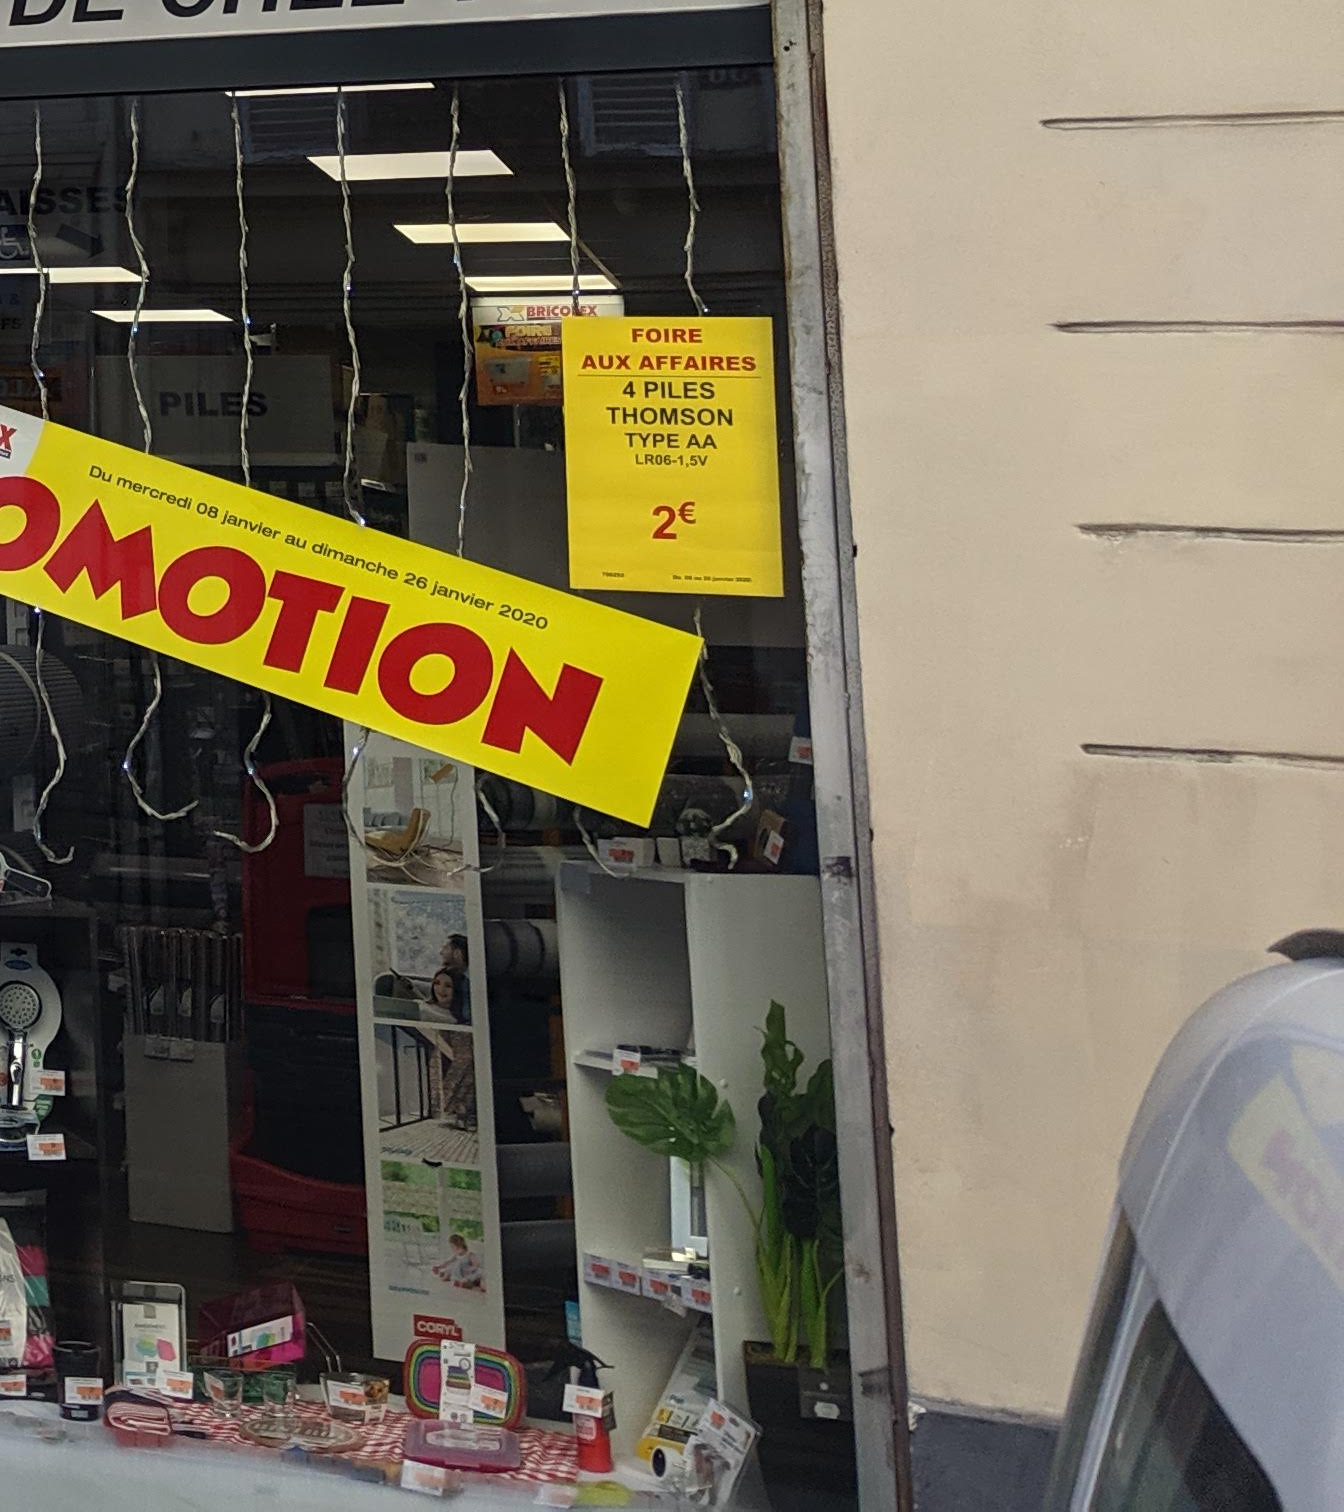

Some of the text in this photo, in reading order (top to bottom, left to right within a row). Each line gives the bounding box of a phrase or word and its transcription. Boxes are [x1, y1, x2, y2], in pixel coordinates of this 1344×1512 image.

[526, 305, 597, 317] BRICOEX
[632, 328, 703, 343] FOIRE
[582, 355, 757, 371] AUX AFFAIRES
[622, 381, 715, 400] 4 PILES
[159, 392, 268, 417] PILES
[606, 407, 734, 426] THOMSON
[625, 433, 717, 449] TYPE AA
[635, 454, 708, 468] LR06-1,5V
[652, 501, 697, 540] 2€
[89, 465, 548, 630] Du mercredi 08 janvier au dimanche 26 janvier 2020
[417, 1320, 459, 1337] CORYL
